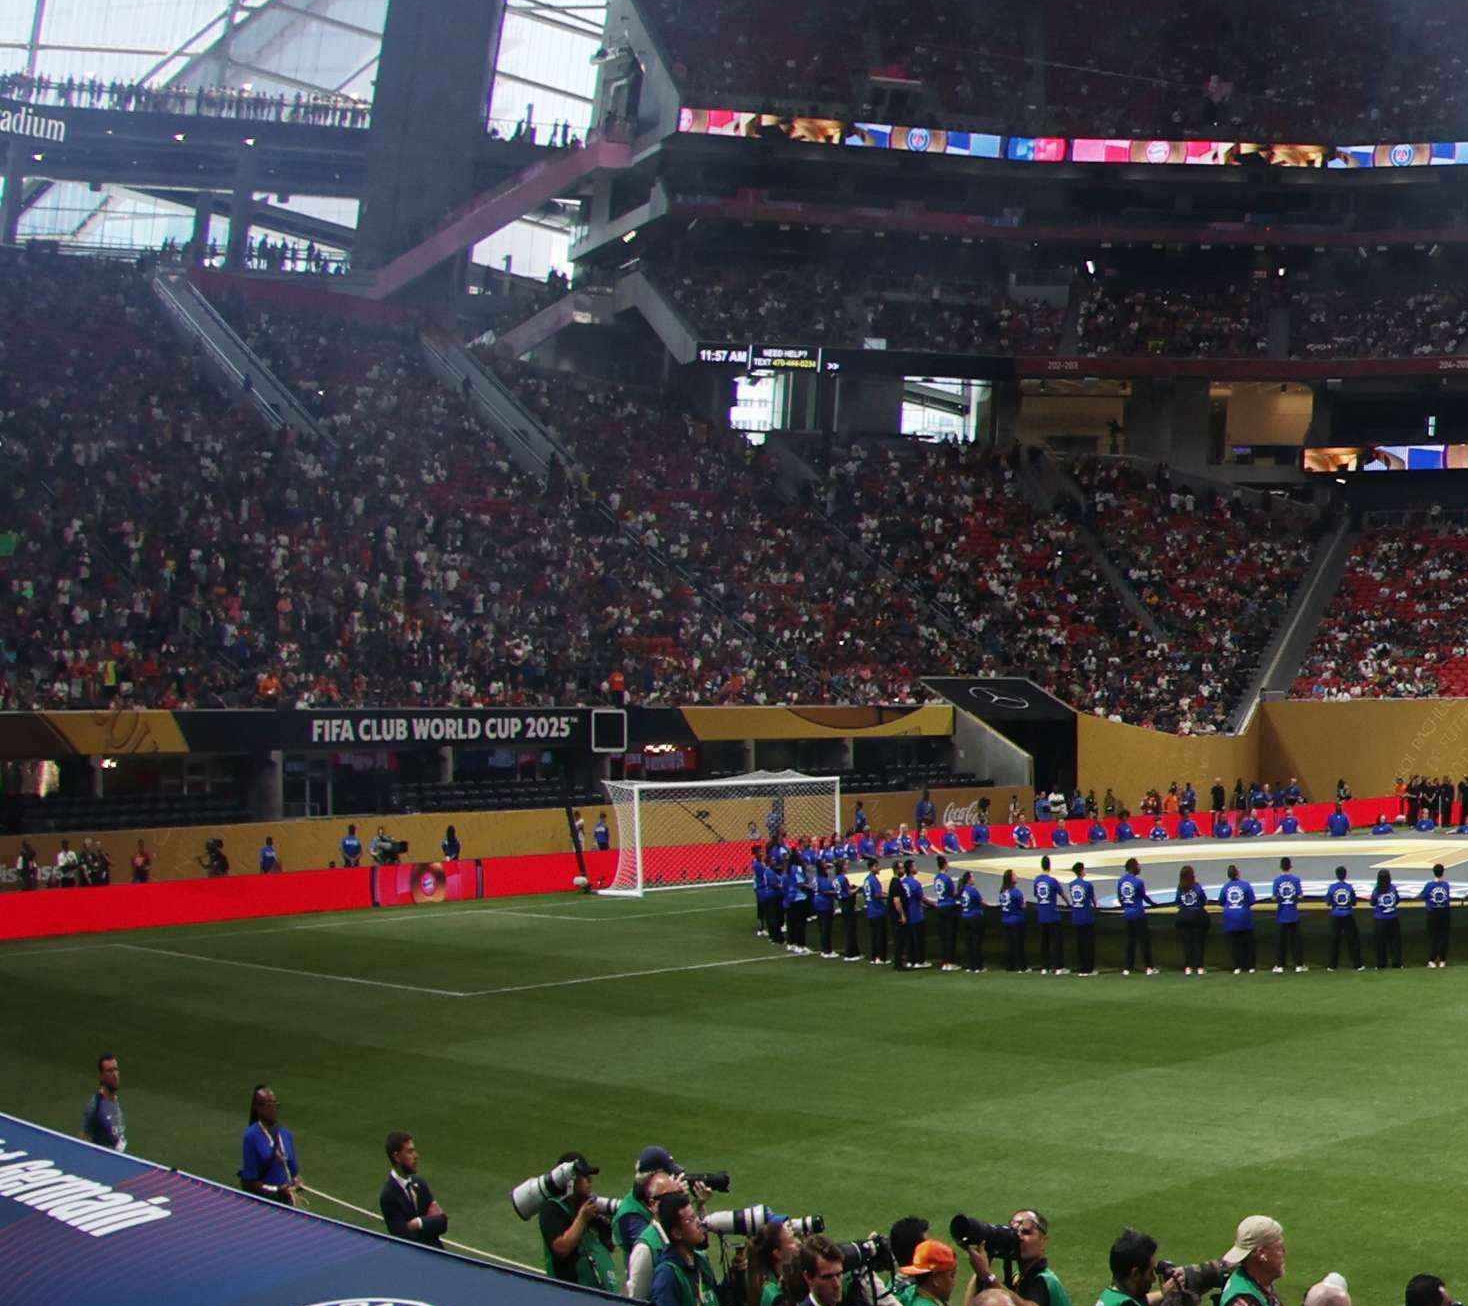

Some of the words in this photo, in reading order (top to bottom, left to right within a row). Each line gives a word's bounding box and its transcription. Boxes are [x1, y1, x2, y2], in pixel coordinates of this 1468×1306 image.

[700, 349, 727, 362] 11:57
[728, 350, 748, 363] AM
[311, 717, 354, 742] FIFA
[358, 717, 408, 741] CLUB
[412, 717, 481, 741] WORLD
[484, 717, 522, 740] CUP
